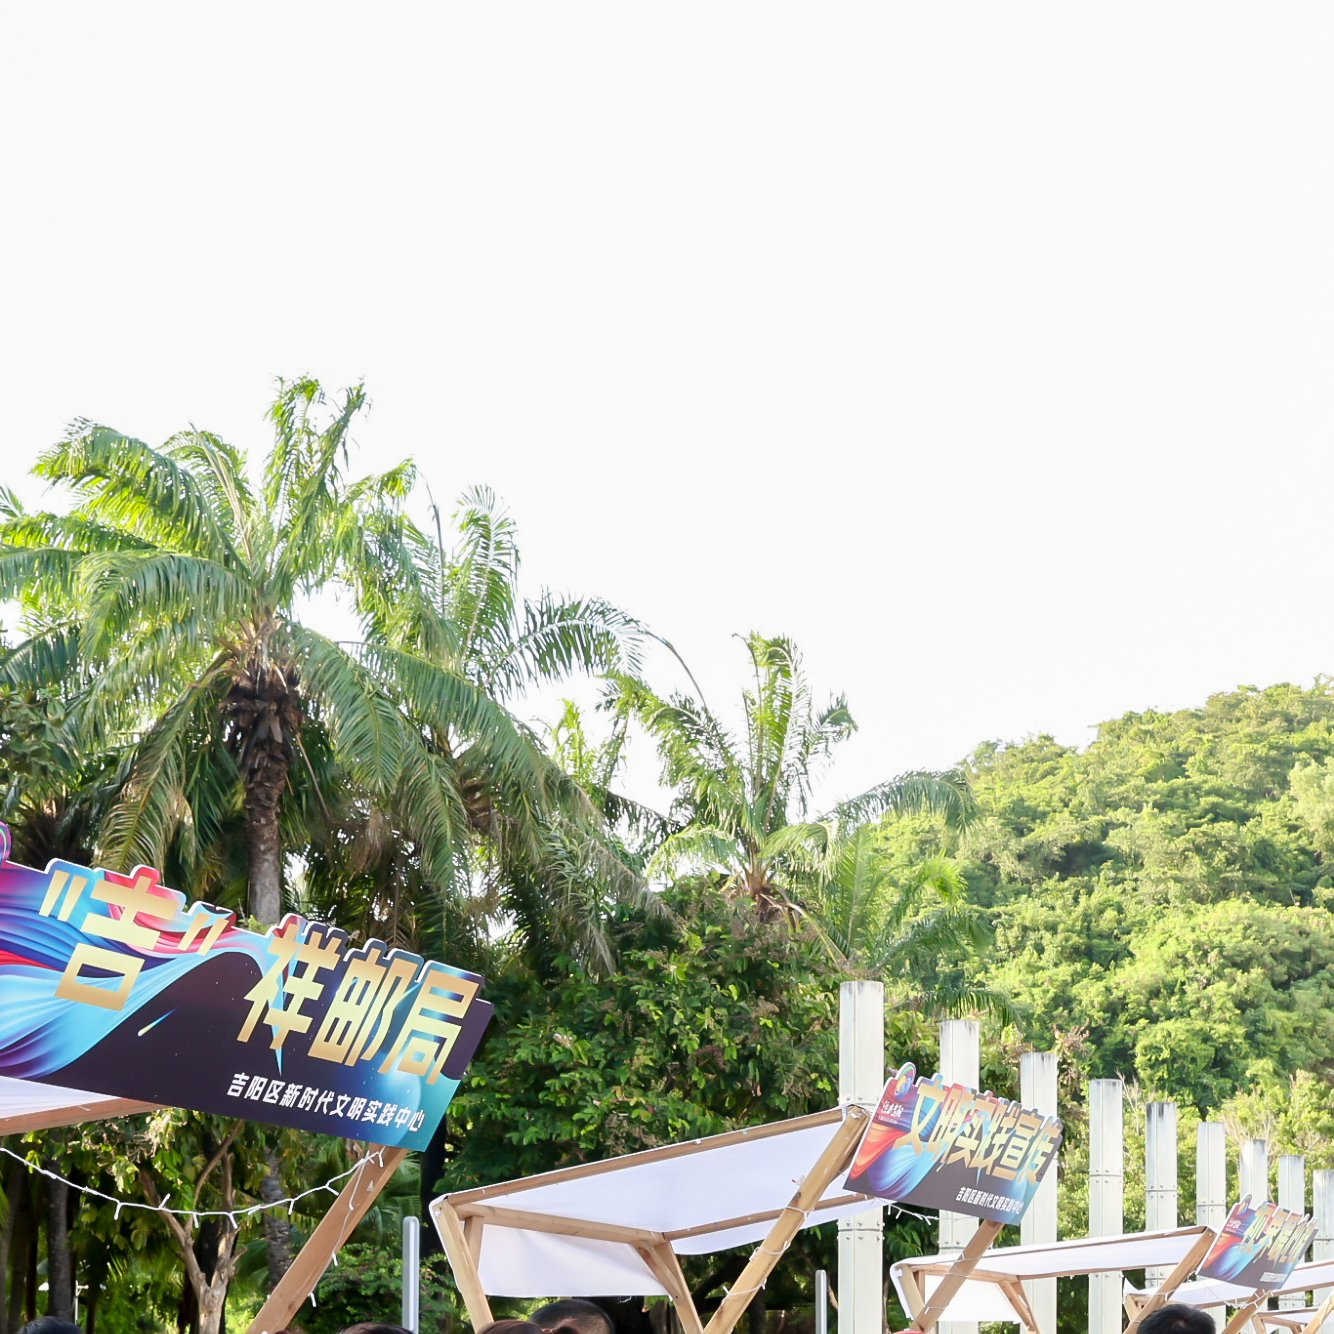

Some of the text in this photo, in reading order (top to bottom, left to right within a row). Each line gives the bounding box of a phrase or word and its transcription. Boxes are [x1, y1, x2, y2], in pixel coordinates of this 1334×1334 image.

[226, 1072, 426, 1133] 吉阳区新时代文明实践中心
[891, 1080, 1062, 1185] 文明实践宣传
